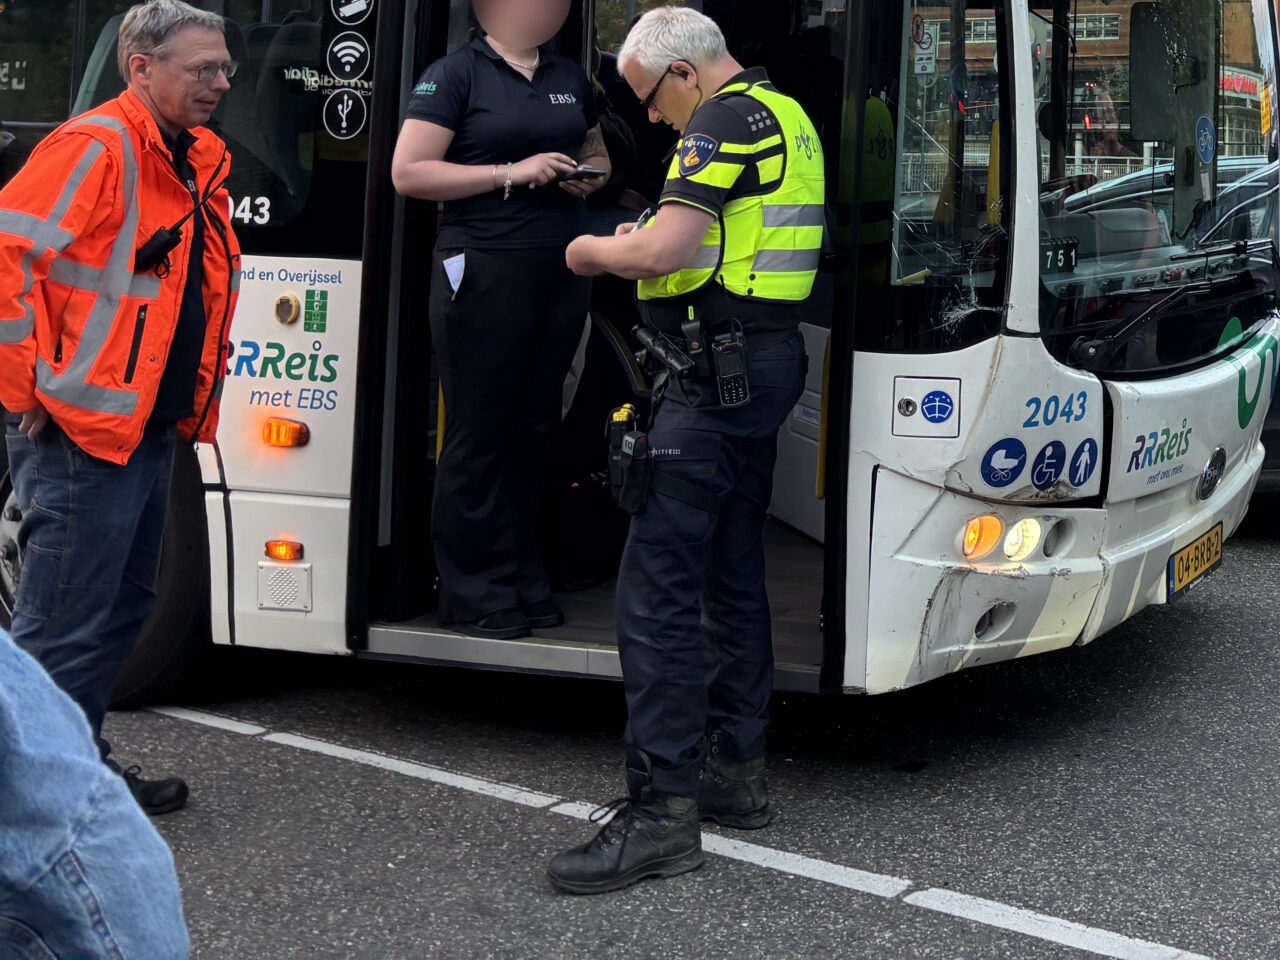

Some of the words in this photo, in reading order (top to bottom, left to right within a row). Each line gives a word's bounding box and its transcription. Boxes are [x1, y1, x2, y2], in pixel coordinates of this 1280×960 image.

[549, 93, 572, 104] EBS
[258, 271, 274, 281] en
[278, 268, 342, 286] Overijssel
[249, 390, 292, 408] met
[297, 388, 338, 411] EBS
[1023, 390, 1088, 429] 2043
[1126, 418, 1193, 474] RRReis
[1177, 530, 1220, 585] 04-BRB-2
